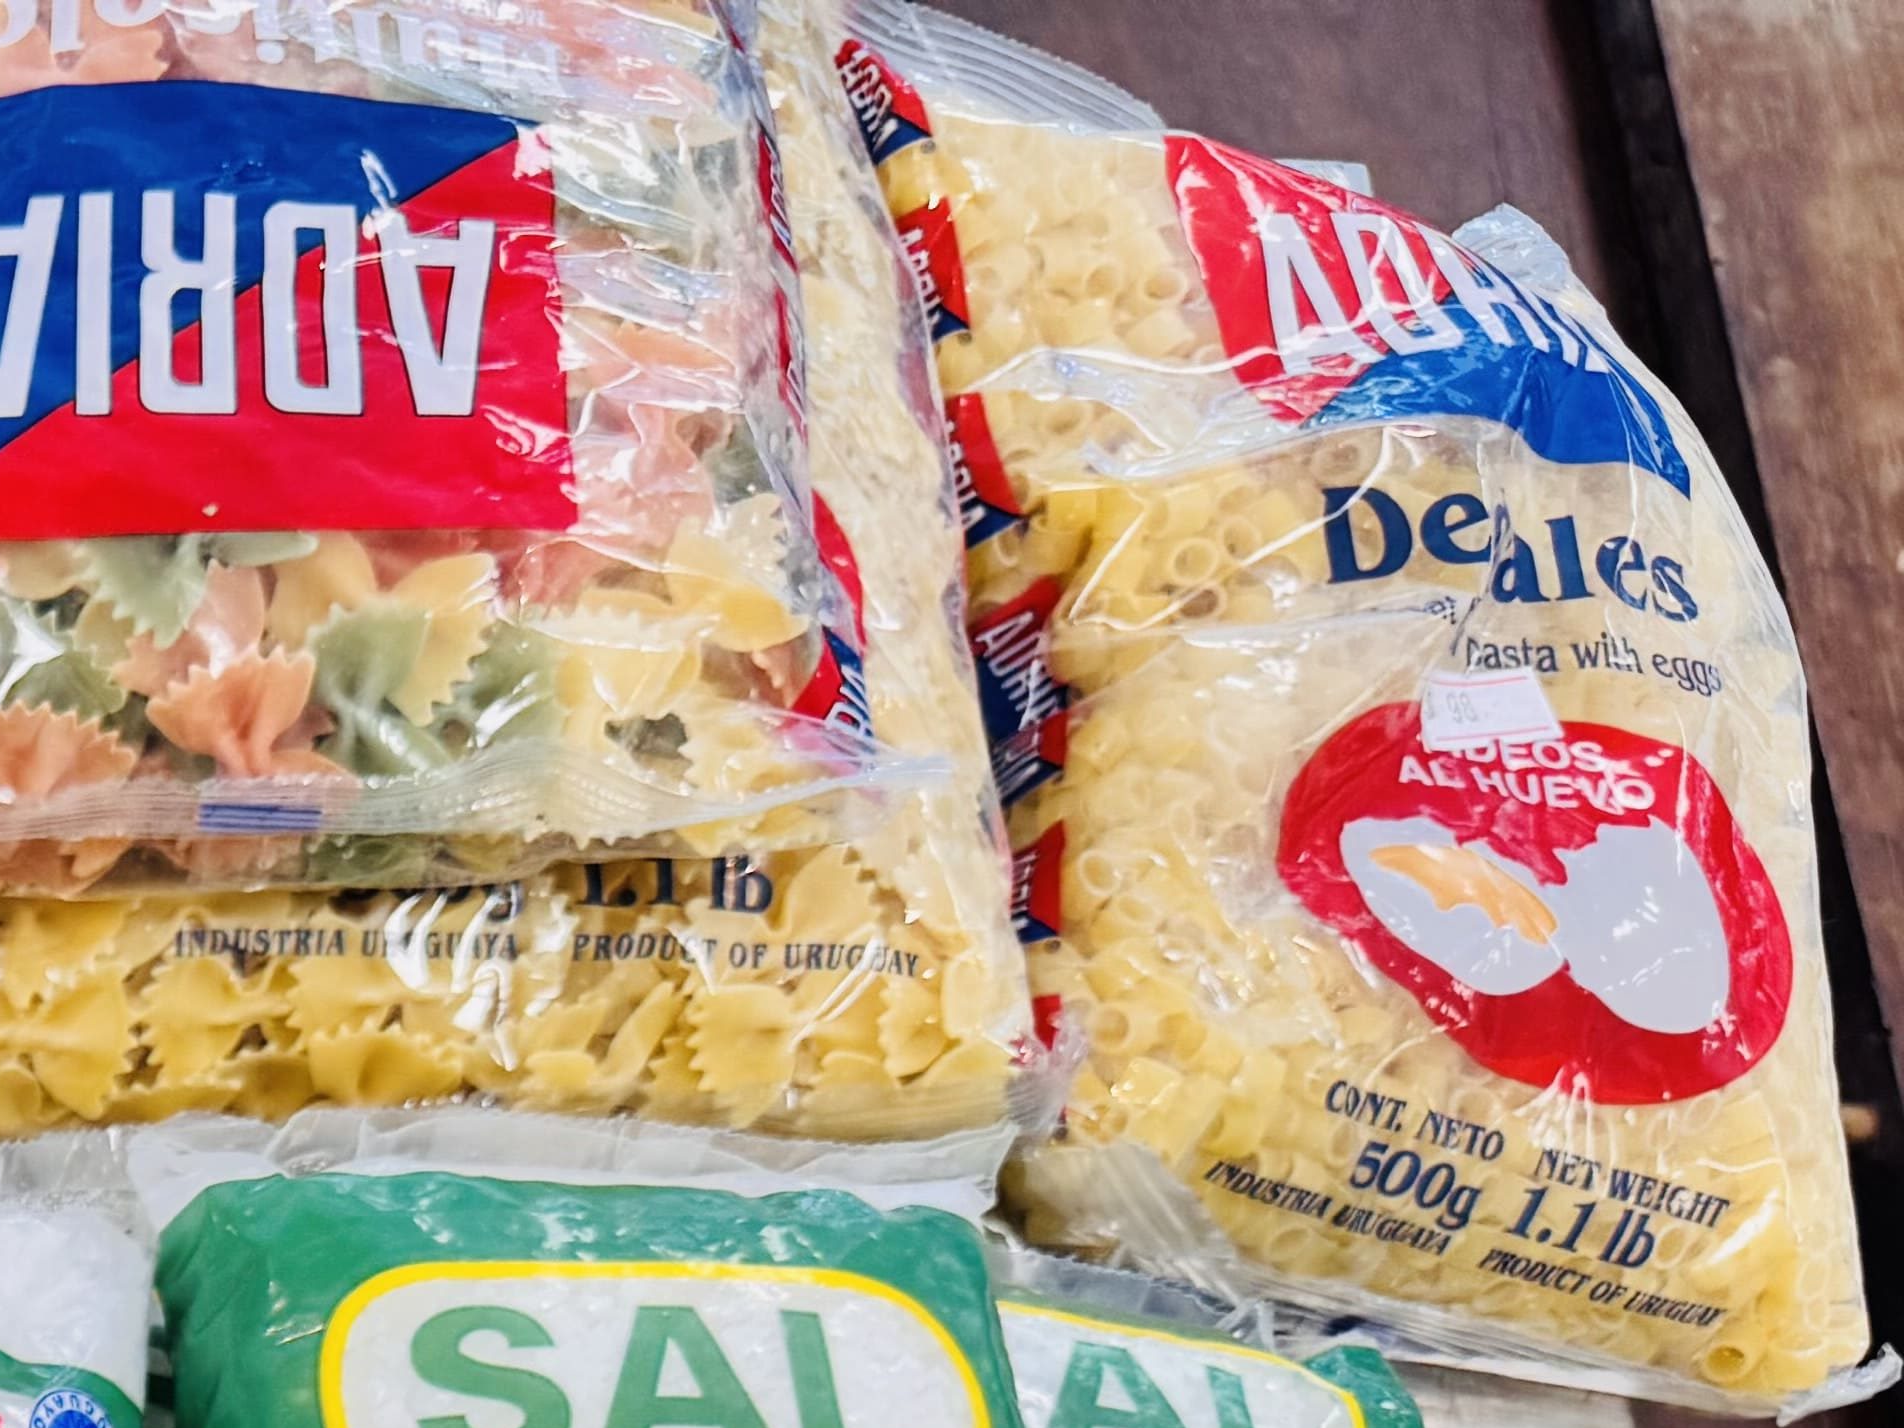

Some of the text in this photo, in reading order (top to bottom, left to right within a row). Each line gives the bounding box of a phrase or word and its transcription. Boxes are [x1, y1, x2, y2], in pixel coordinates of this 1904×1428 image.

[1570, 632, 1723, 698] with eggs
[1398, 754, 1656, 815] AL HUEVO
[171, 925, 923, 980] INDUSTRIA PRODUCT OF URUGUAY
[1324, 1079, 1731, 1229] CONT. NETO NET WEIGHT
[1203, 1159, 1728, 1328] INDUSTRIA URUGUAYA PRODUCT OF URUGUAY
[1349, 1140, 1657, 1269] 500g 1.1 lb
